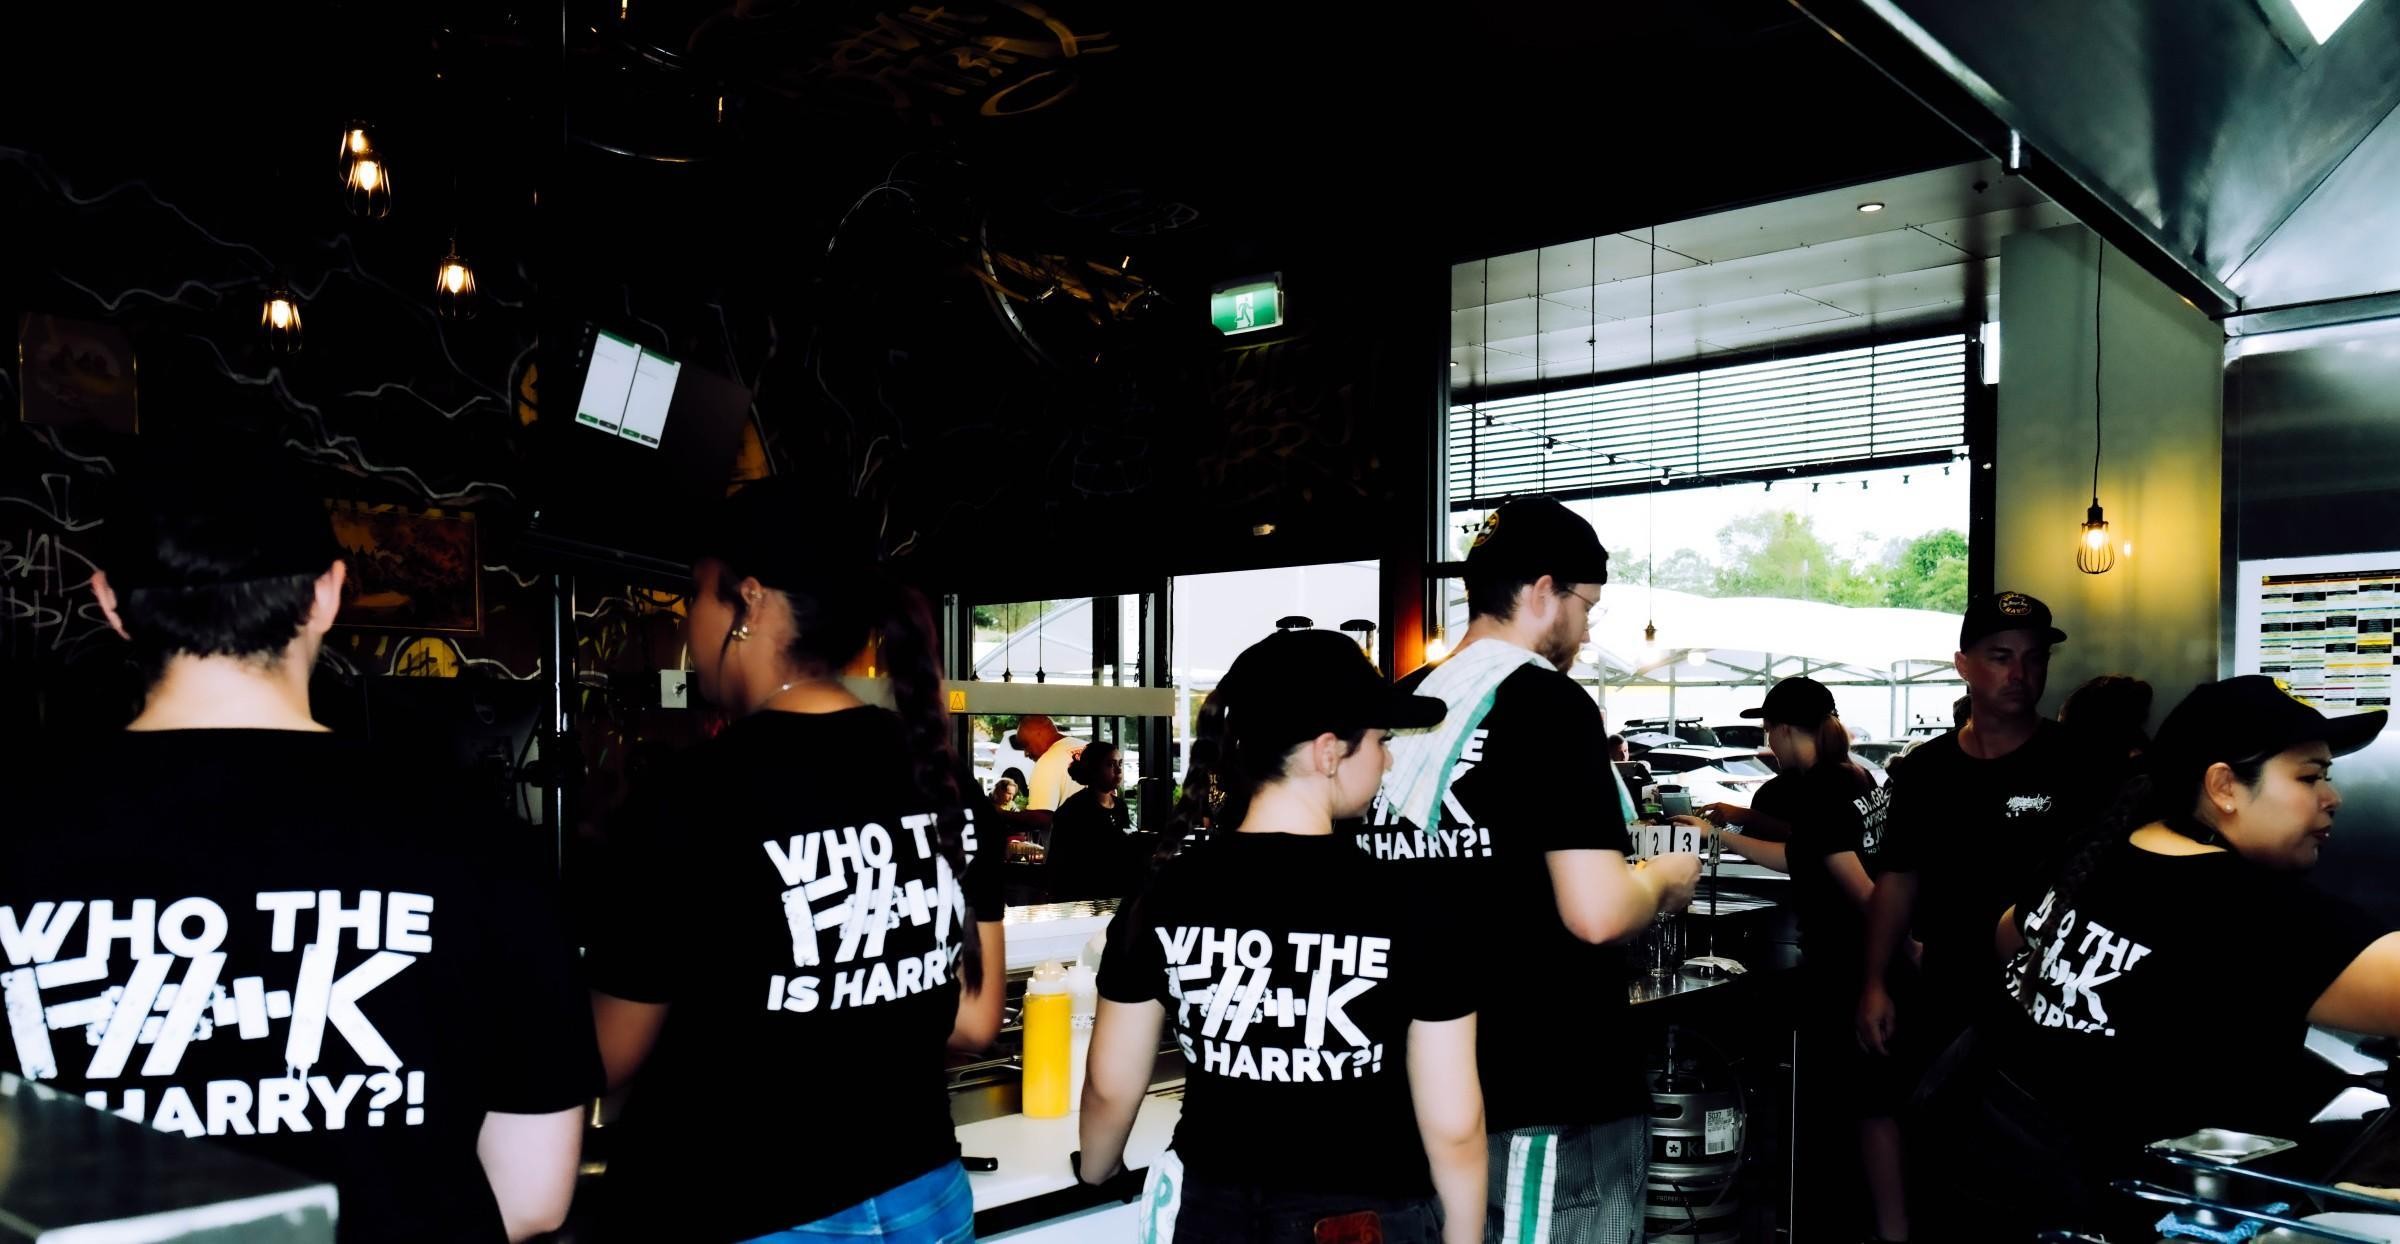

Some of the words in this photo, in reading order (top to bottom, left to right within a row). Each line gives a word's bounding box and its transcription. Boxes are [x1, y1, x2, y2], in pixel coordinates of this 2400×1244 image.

[763, 822, 893, 887] WHO
[0, 897, 229, 966] WHO
[256, 889, 434, 954] THE
[1154, 926, 1273, 970] WHO
[1287, 931, 1391, 979] THE
[767, 974, 821, 1013] IS
[1203, 1039, 1384, 1083] HARRY?!
